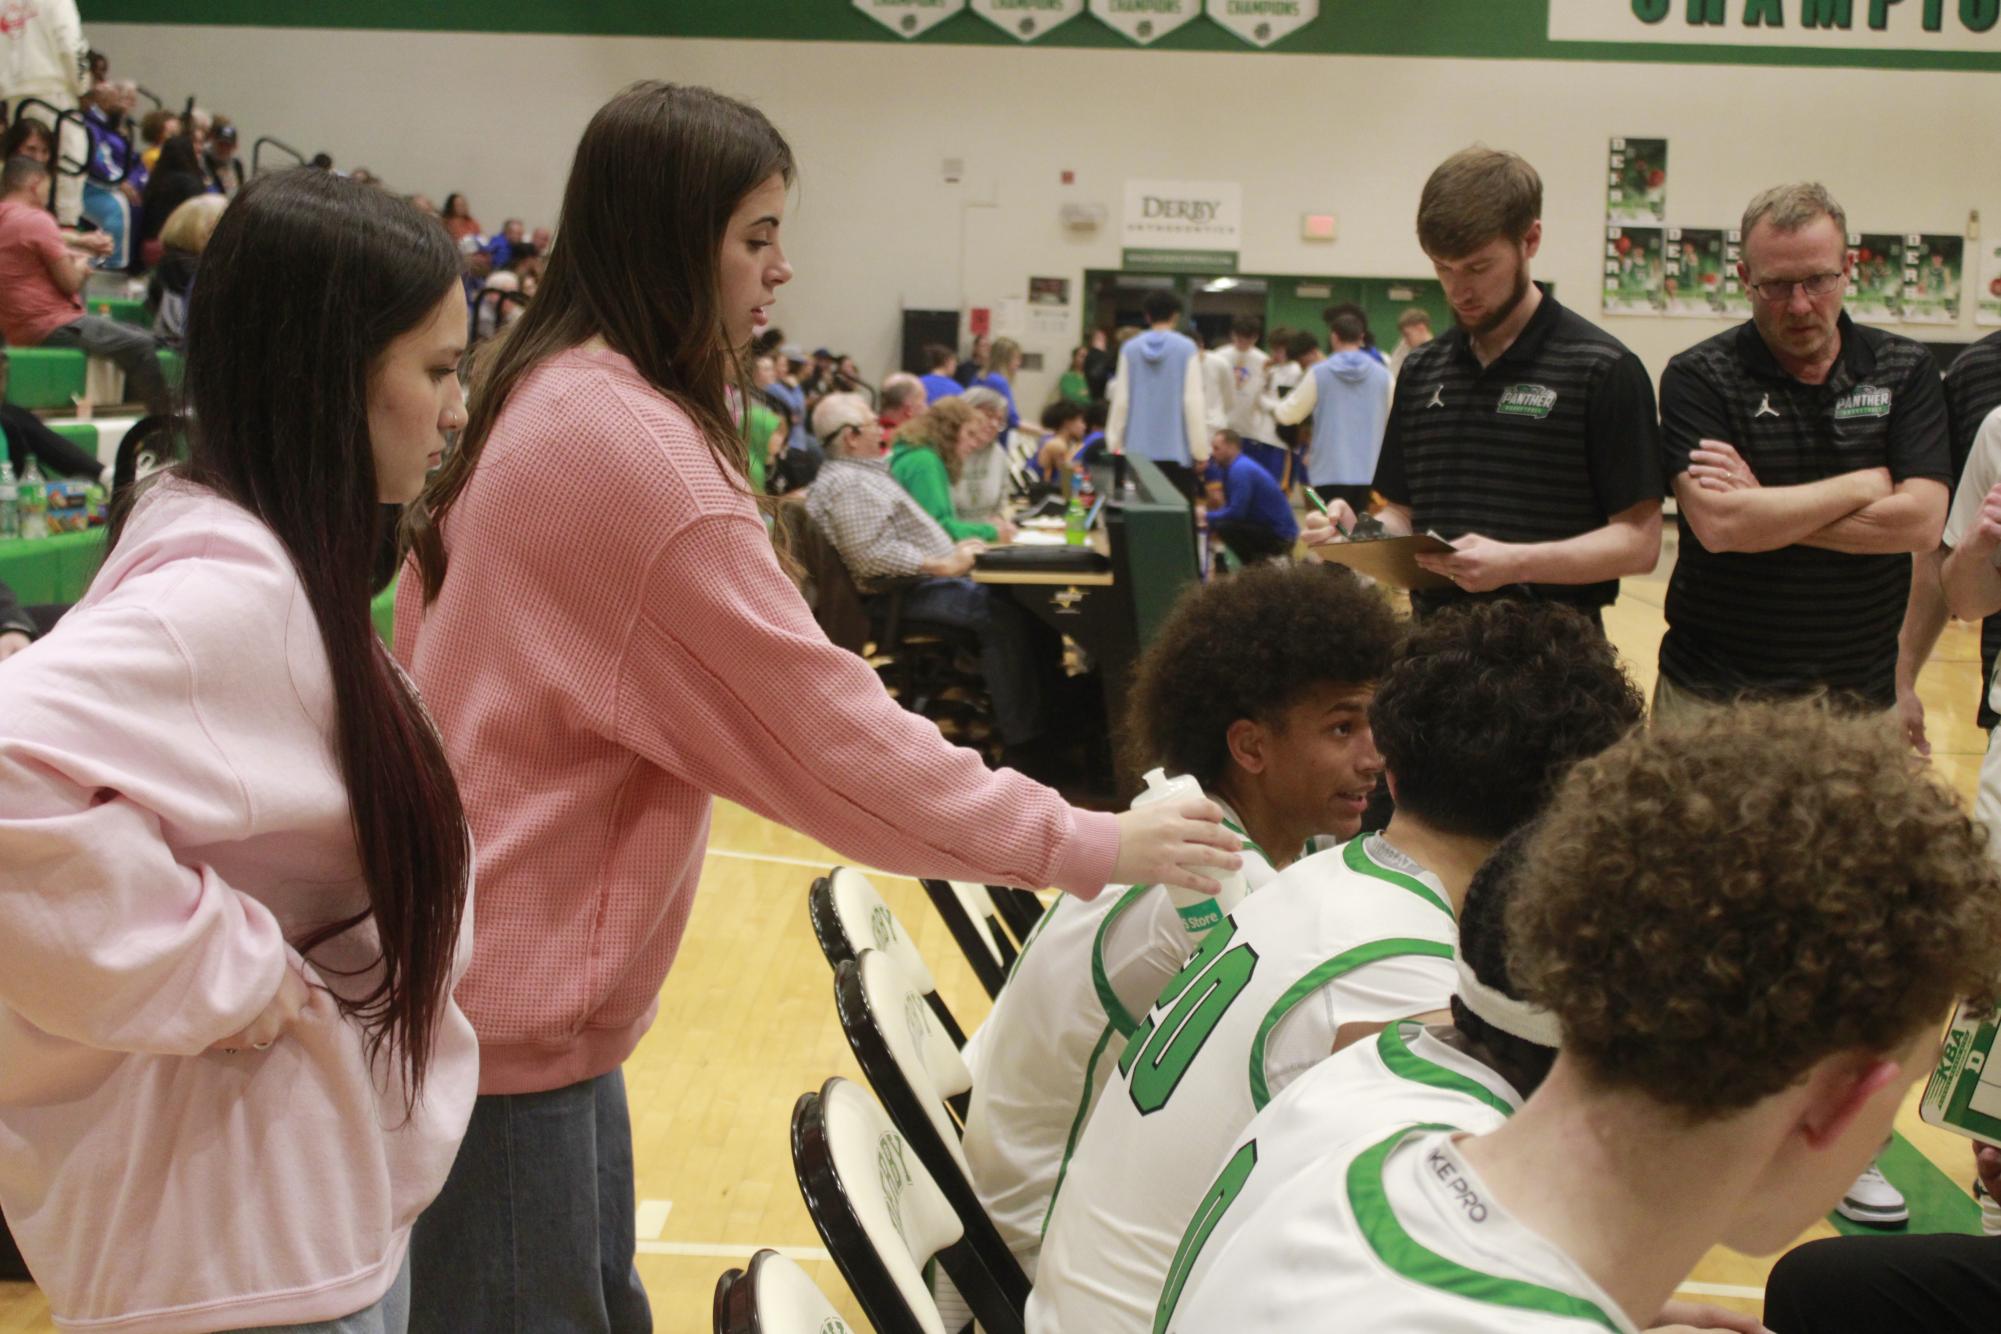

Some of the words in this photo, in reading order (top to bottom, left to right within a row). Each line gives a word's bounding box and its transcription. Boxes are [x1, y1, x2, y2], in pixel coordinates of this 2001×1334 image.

[1501, 390, 1555, 408] PANTHER
[1836, 392, 1889, 410] PANTHER
[1188, 912, 1219, 929] Store
[1447, 1178, 1488, 1223] PRO
